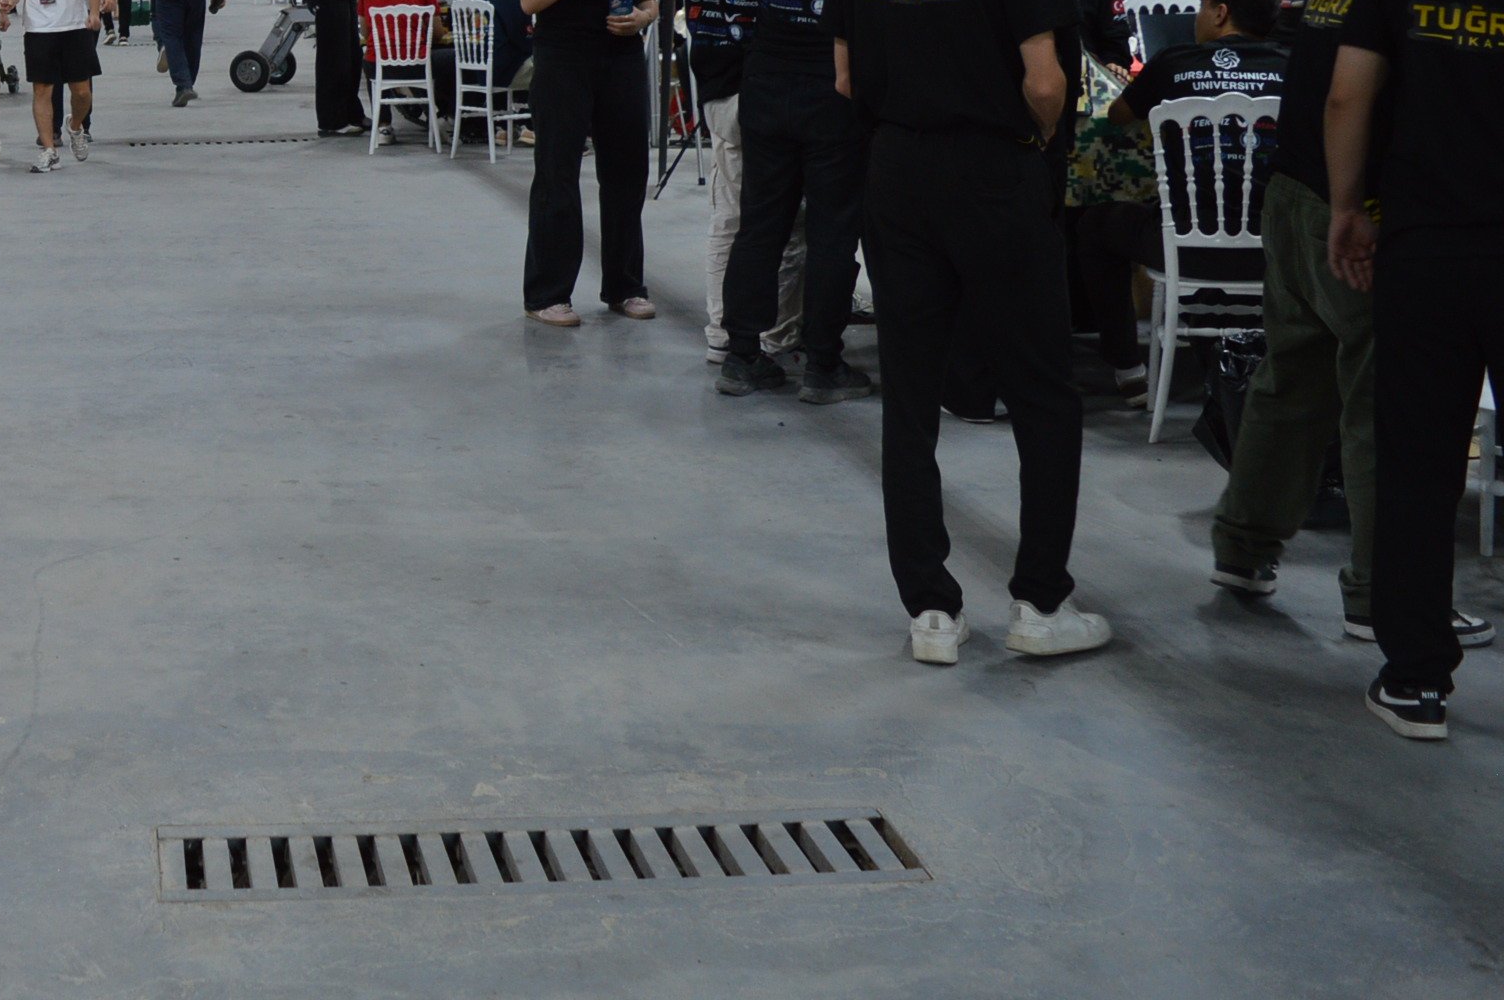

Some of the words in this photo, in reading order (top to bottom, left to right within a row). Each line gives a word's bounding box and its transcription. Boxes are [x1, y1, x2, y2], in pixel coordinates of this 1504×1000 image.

[1413, 3, 1504, 37] TUĞR
[1174, 71, 1212, 83] BURSA
[1215, 71, 1283, 82] TECHNICAL
[1192, 81, 1265, 91] UNIVERSITY
